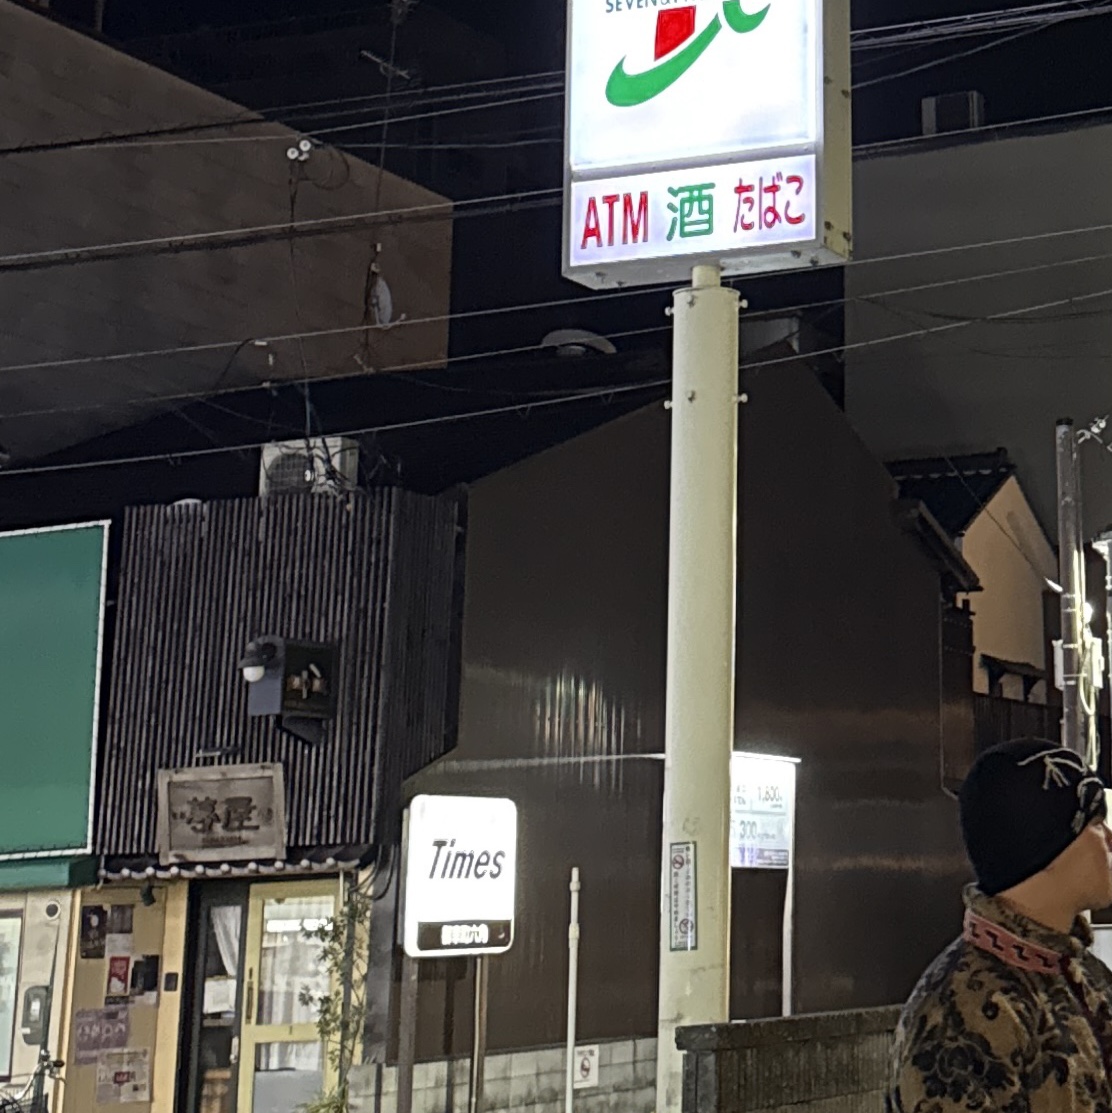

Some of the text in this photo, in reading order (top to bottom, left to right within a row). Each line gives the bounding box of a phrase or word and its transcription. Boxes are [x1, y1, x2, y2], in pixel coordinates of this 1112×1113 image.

[580, 171, 806, 250] ATM 酒 たばこ
[428, 838, 506, 880] Times
